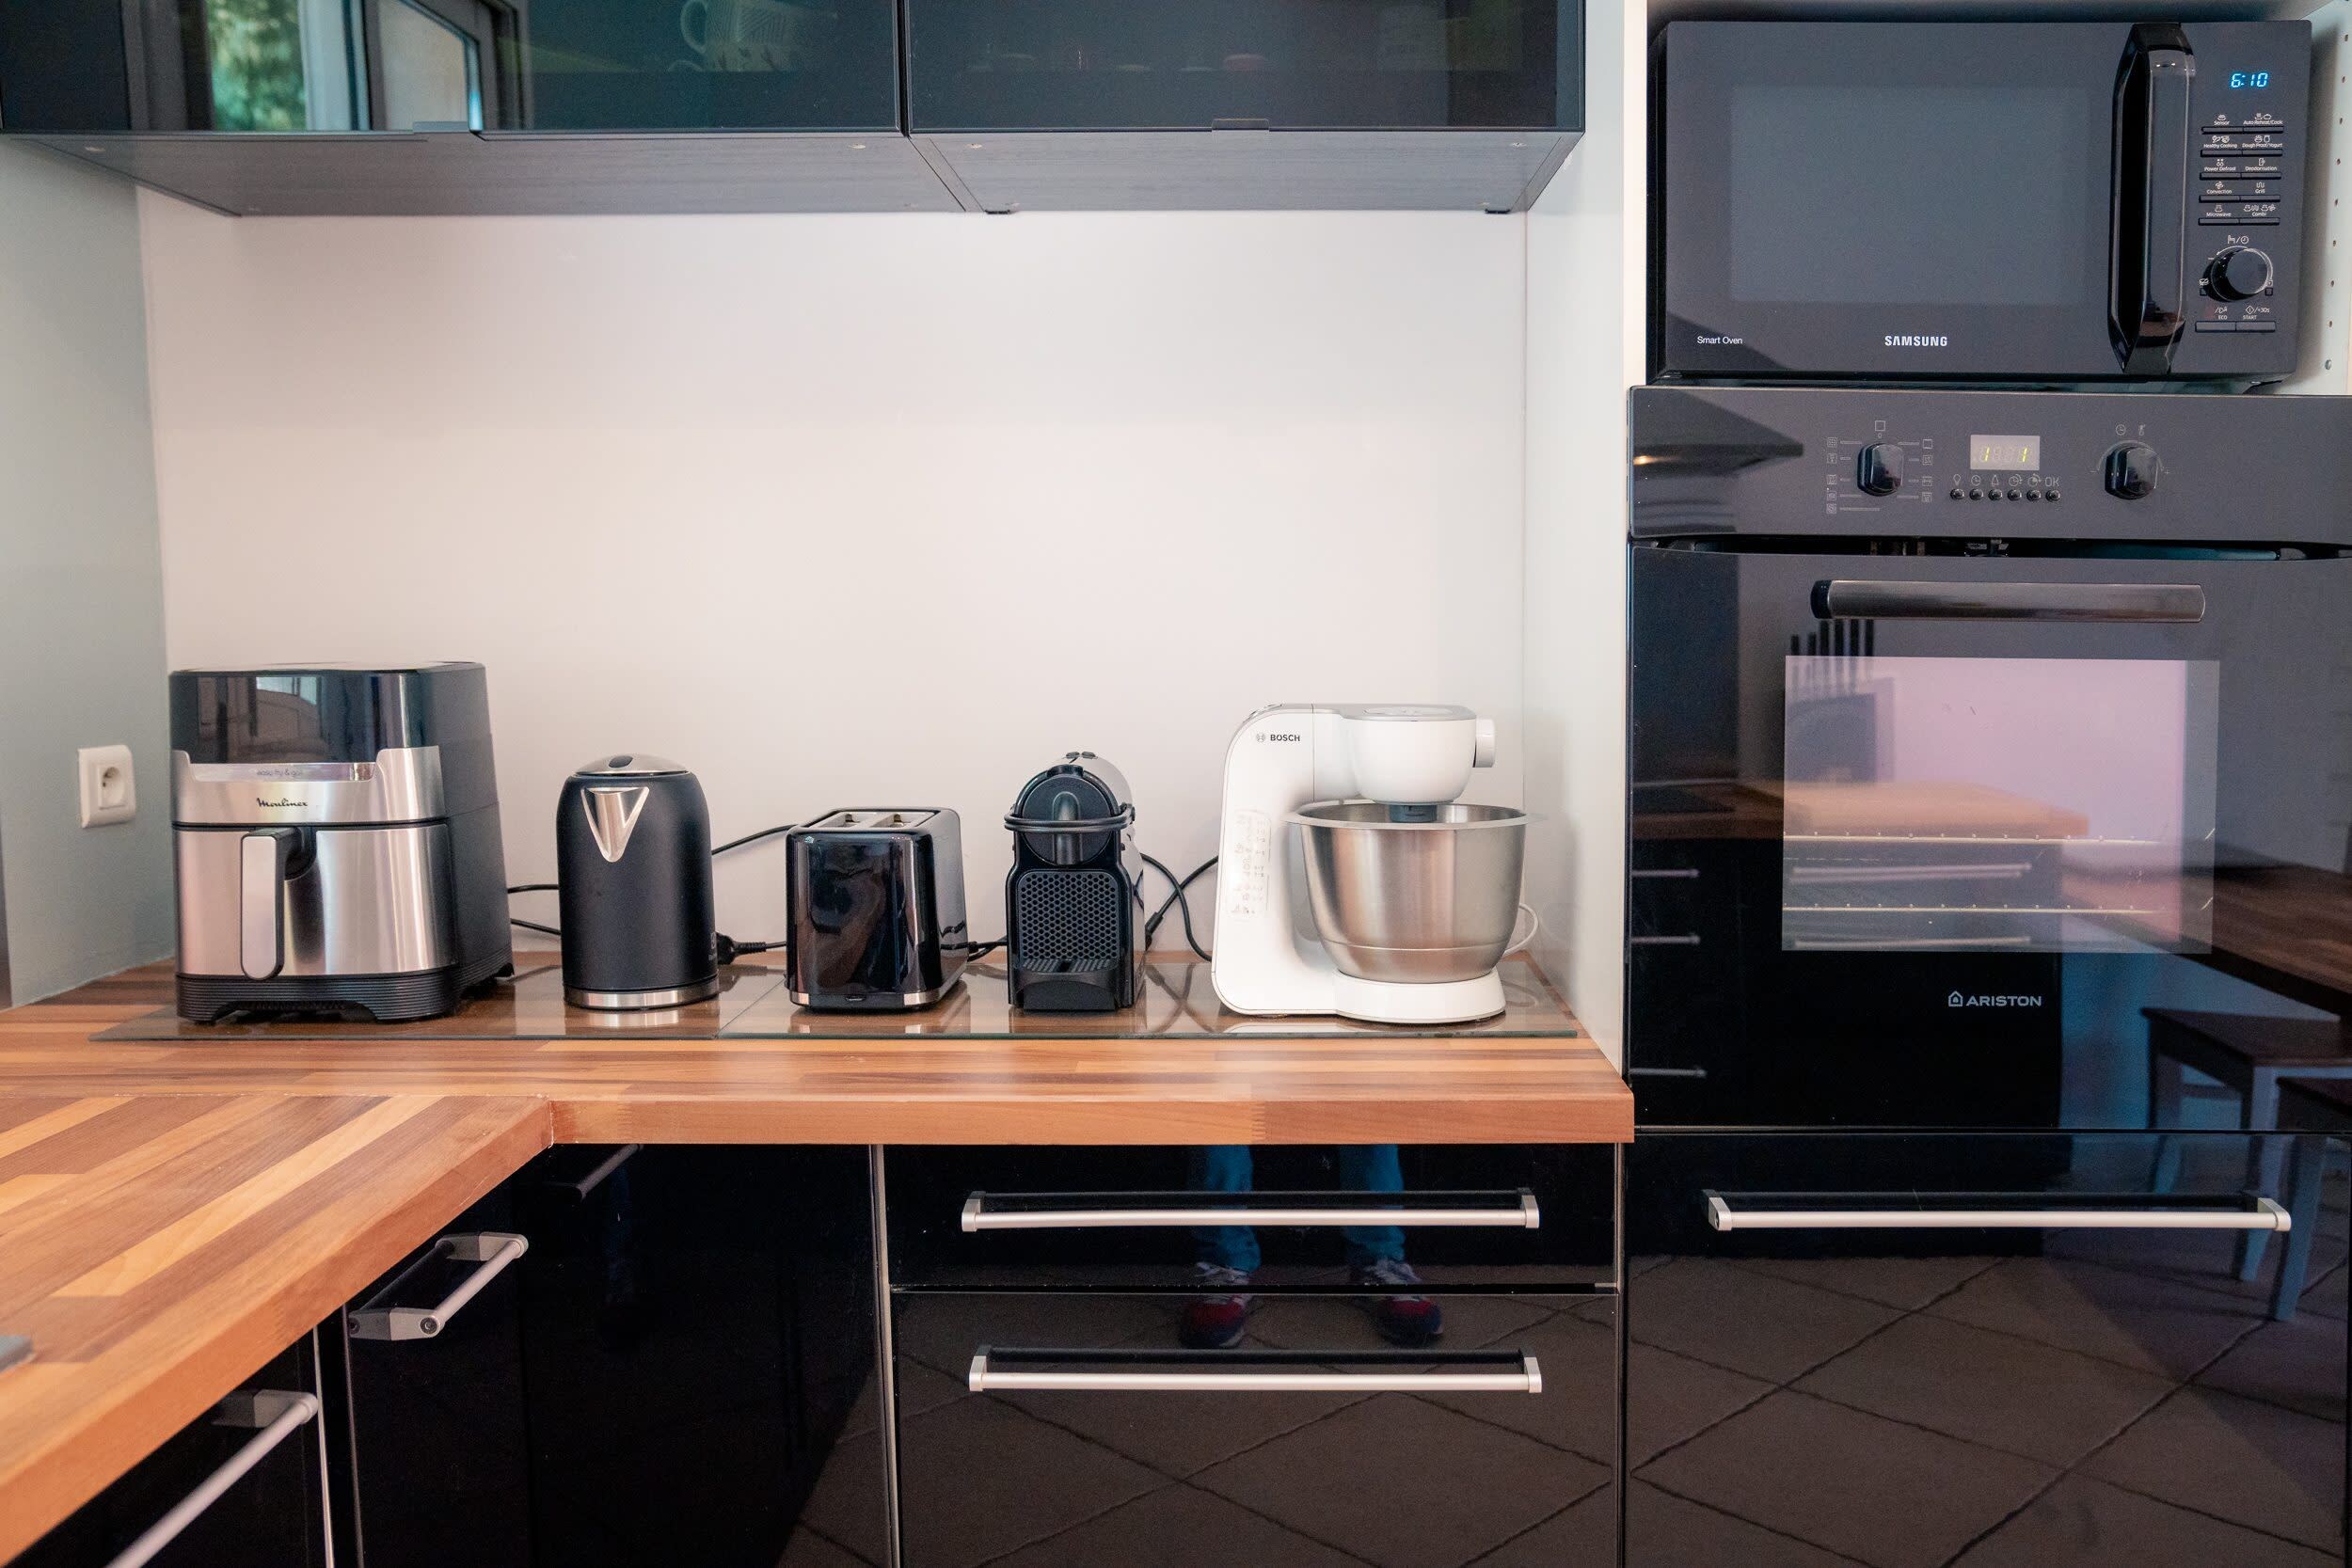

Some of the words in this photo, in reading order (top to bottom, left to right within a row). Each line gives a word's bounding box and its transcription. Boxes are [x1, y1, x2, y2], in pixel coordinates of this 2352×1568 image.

[2231, 72, 2268, 87] 6:10
[1697, 336, 1721, 344] Smart
[1722, 336, 1743, 344] Oven
[1883, 335, 1948, 347] SAMSUNG
[2044, 476, 2060, 487] OK
[1270, 734, 1300, 742] BOSCH
[256, 797, 309, 807] Moulinex
[1965, 995, 2042, 1007] ARISTON
